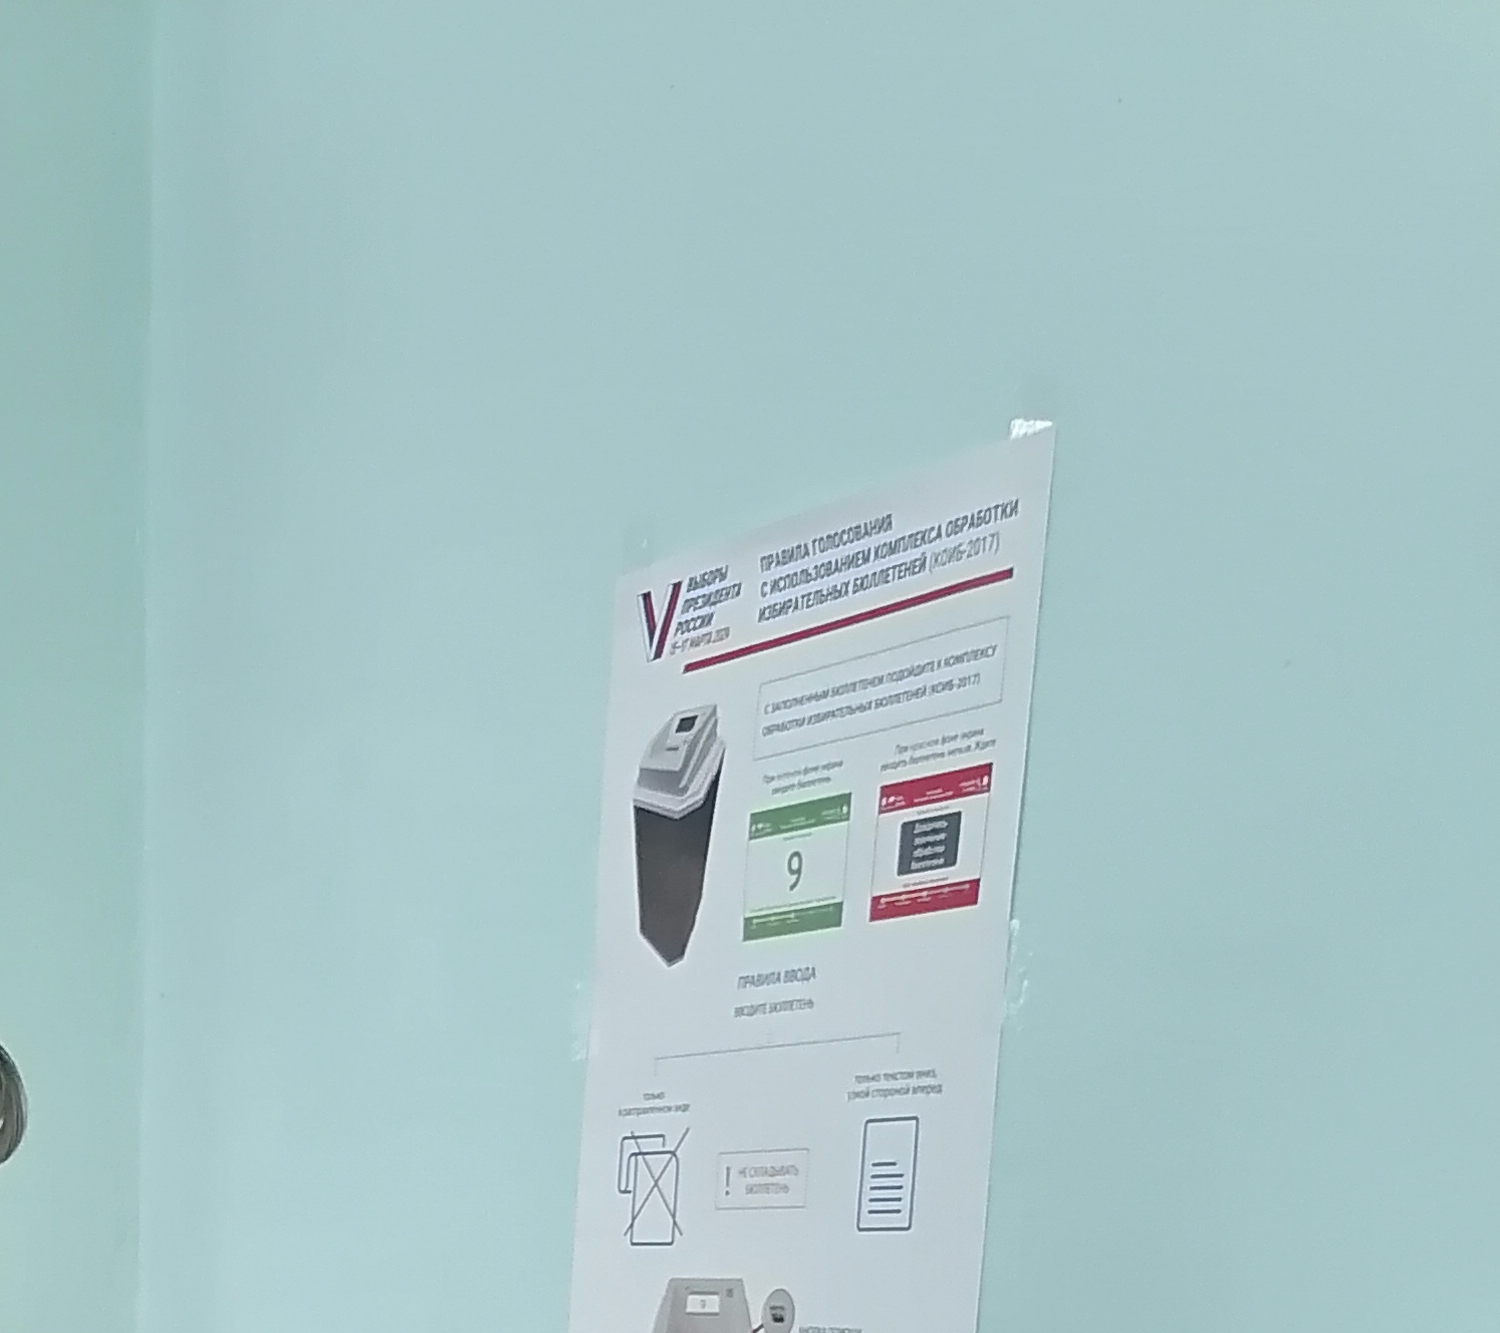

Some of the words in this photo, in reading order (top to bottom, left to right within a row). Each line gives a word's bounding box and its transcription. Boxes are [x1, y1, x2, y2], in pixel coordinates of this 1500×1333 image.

[759, 542, 810, 573] ПРАВИЛА
[811, 513, 893, 556] ГОЛОСОВАНИЯ
[760, 581, 768, 598] С
[769, 547, 871, 595] ИСПОЛЬЗОВАНИЕМ
[873, 524, 942, 561] КОМПЛЕКСА
[945, 498, 1019, 539] ОБРАБОТКИ
[686, 564, 729, 594] ВЫБОРЫ
[757, 579, 850, 622] ИЗБИРАТЕЛЬНЫХ
[851, 551, 927, 596] БЮЛЛЕТЕНЕЙ
[928, 530, 1001, 574] (КОИБ-2017)
[680, 582, 743, 615] ПРЕЗИДЕНТА
[674, 611, 716, 638] РОССИИ
[886, 660, 935, 684] ПОДОЙДИТЕ
[944, 644, 998, 668] КОМПЛЕКСУ
[761, 716, 805, 737] ОБРАБОТКИ
[806, 700, 873, 726] ИЗБИРАТЕЛЬНЫХ
[874, 685, 927, 710] БЮЛЛЕТЕНЕЙ
[787, 850, 804, 892] 9
[737, 971, 781, 989] ПРАВИЛА
[782, 966, 816, 984] ВВОДА
[768, 999, 814, 1014] БЮЛЛЕТЕНЬ
